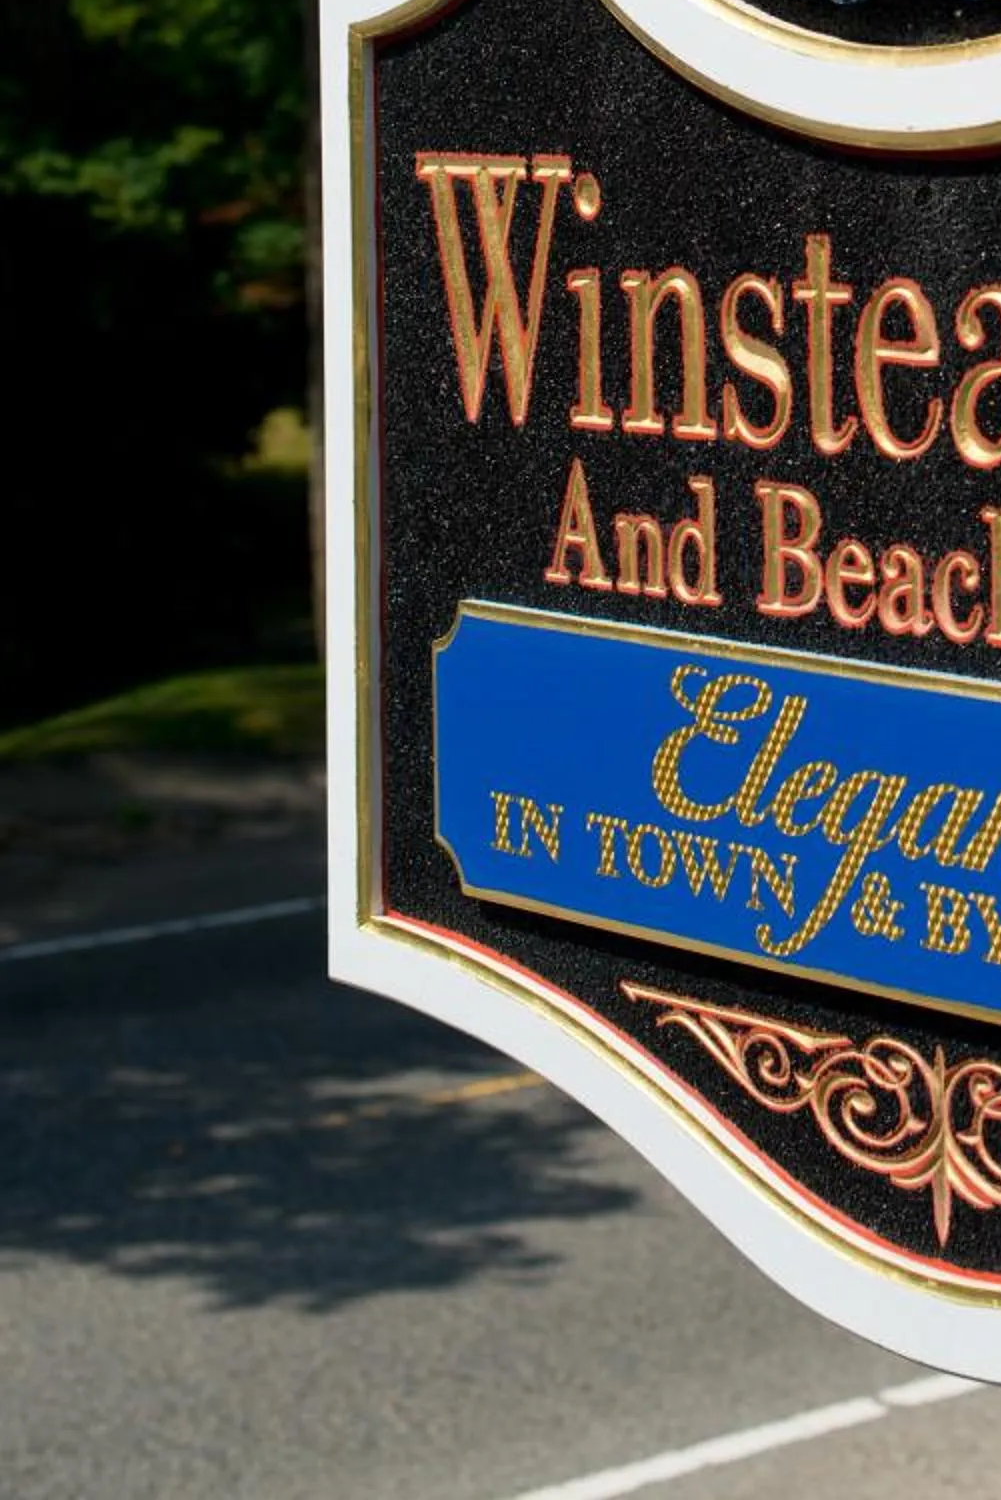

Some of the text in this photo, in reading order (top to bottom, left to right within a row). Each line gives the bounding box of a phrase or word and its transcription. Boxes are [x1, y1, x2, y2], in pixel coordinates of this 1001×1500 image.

[544, 457, 722, 606] And
[489, 791, 563, 864] IN
[585, 812, 801, 919] TOWN
[850, 871, 905, 941] &
